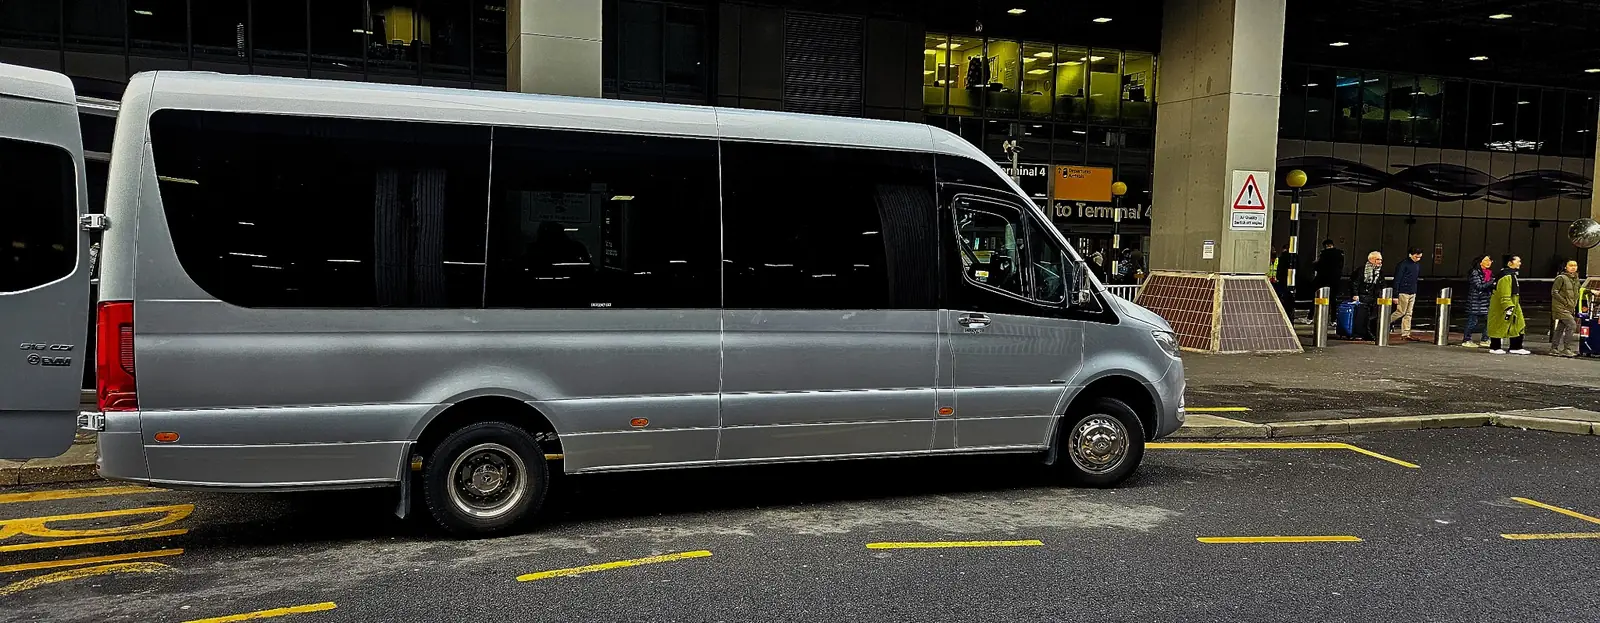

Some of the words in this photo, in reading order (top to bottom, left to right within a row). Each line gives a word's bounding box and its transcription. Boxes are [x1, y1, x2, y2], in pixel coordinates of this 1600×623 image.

[1039, 166, 1046, 177] 4
[1055, 202, 1072, 217] to
[1076, 202, 1142, 219] Termnal
